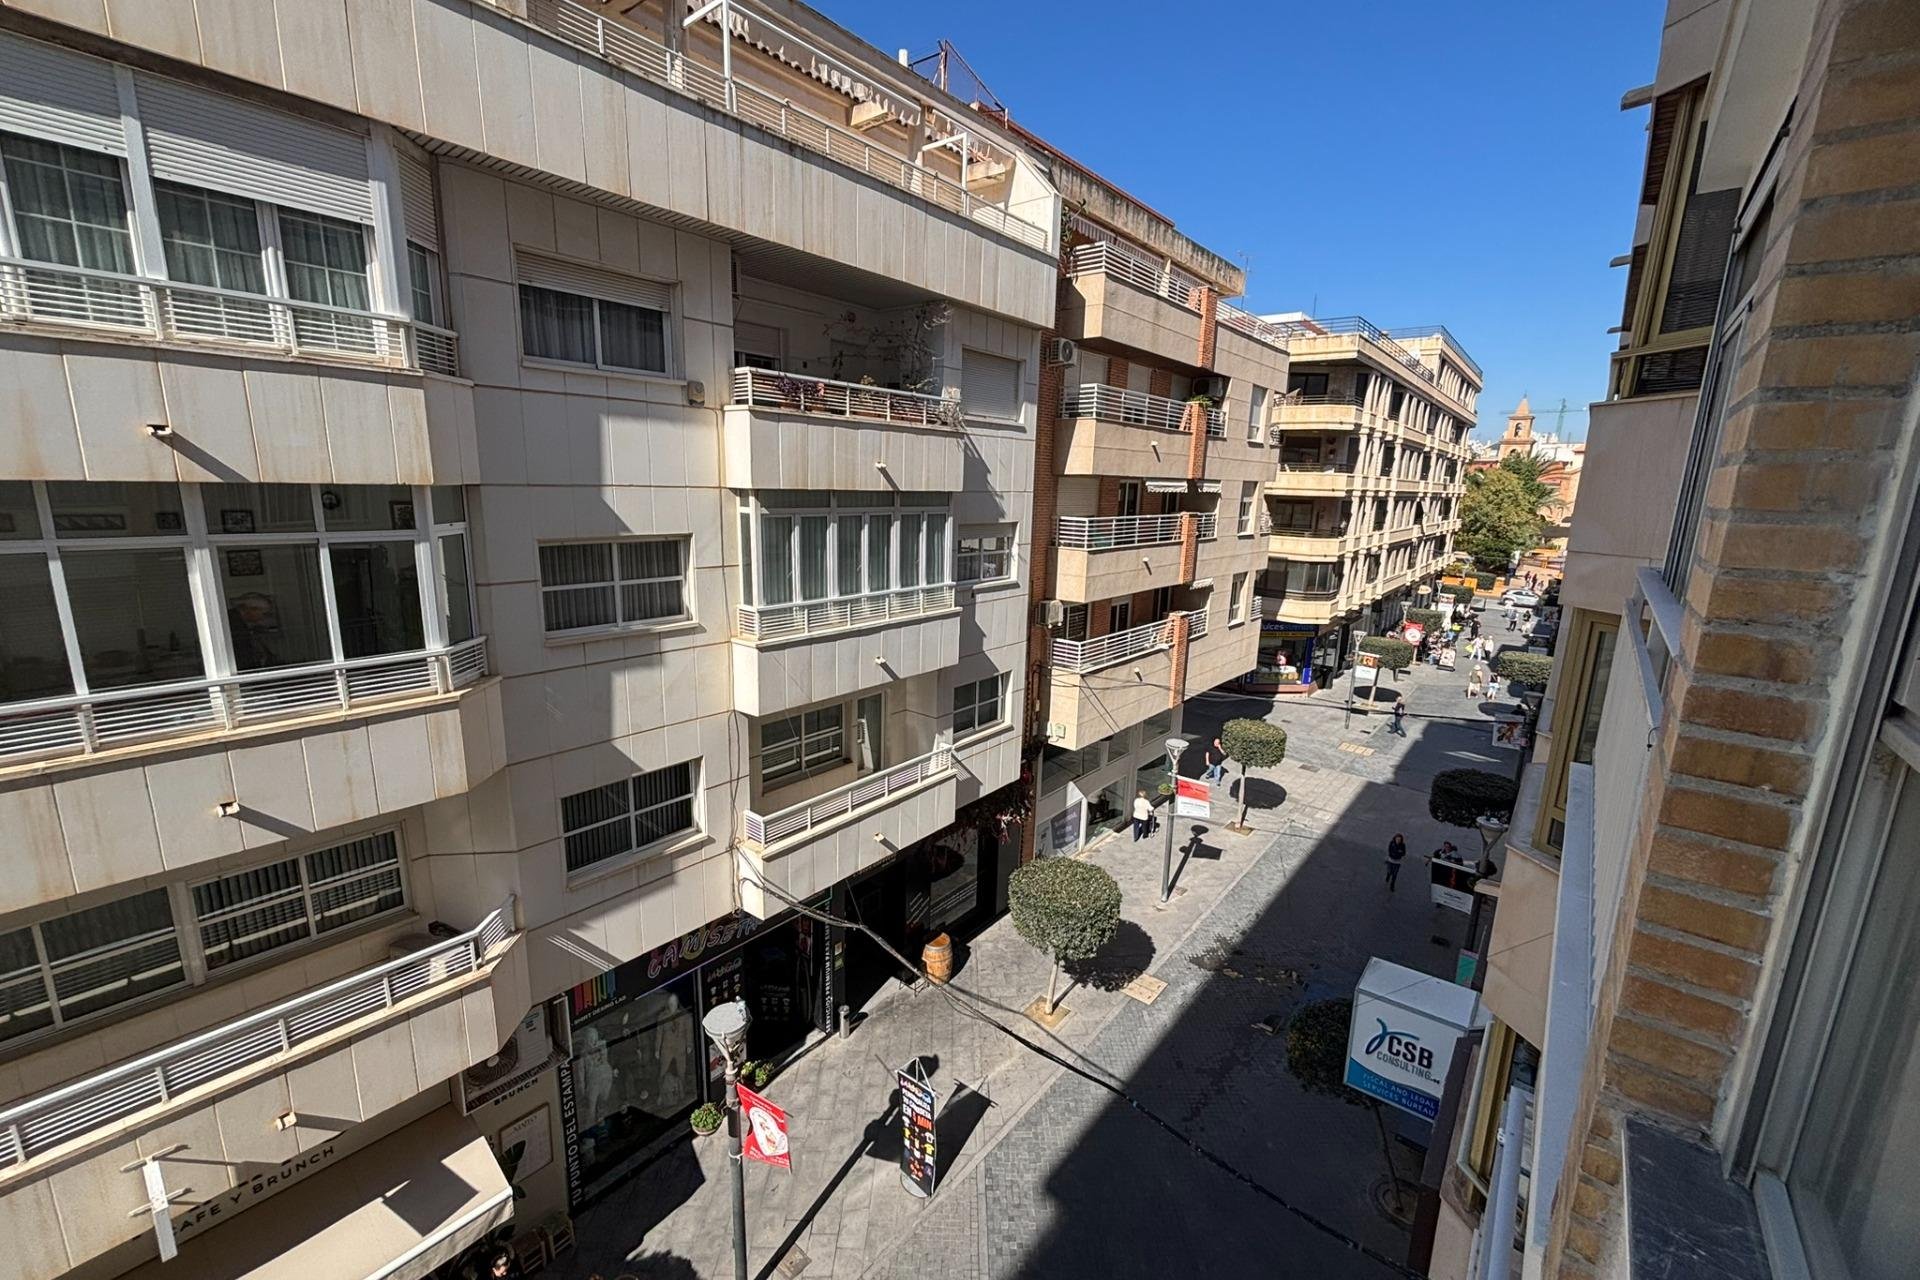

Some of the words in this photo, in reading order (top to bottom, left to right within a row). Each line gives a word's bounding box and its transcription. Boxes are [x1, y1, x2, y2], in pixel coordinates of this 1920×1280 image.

[1262, 622, 1284, 631] ulces
[1387, 1034, 1433, 1070] CSB
[494, 1077, 539, 1106] BRUNCH
[1362, 1080, 1399, 1101] SERVICES
[1401, 1098, 1435, 1117] BUREAU
[1363, 1073, 1390, 1090] FISCAL
[1391, 1085, 1408, 1097] AND
[1410, 1092, 1436, 1109] LEGAL
[566, 1118, 578, 1144] DEL
[230, 1192, 242, 1205] Y
[253, 1146, 335, 1195] BRUNCH
[568, 1144, 582, 1189] PUNTO
[571, 1186, 583, 1206] TU
